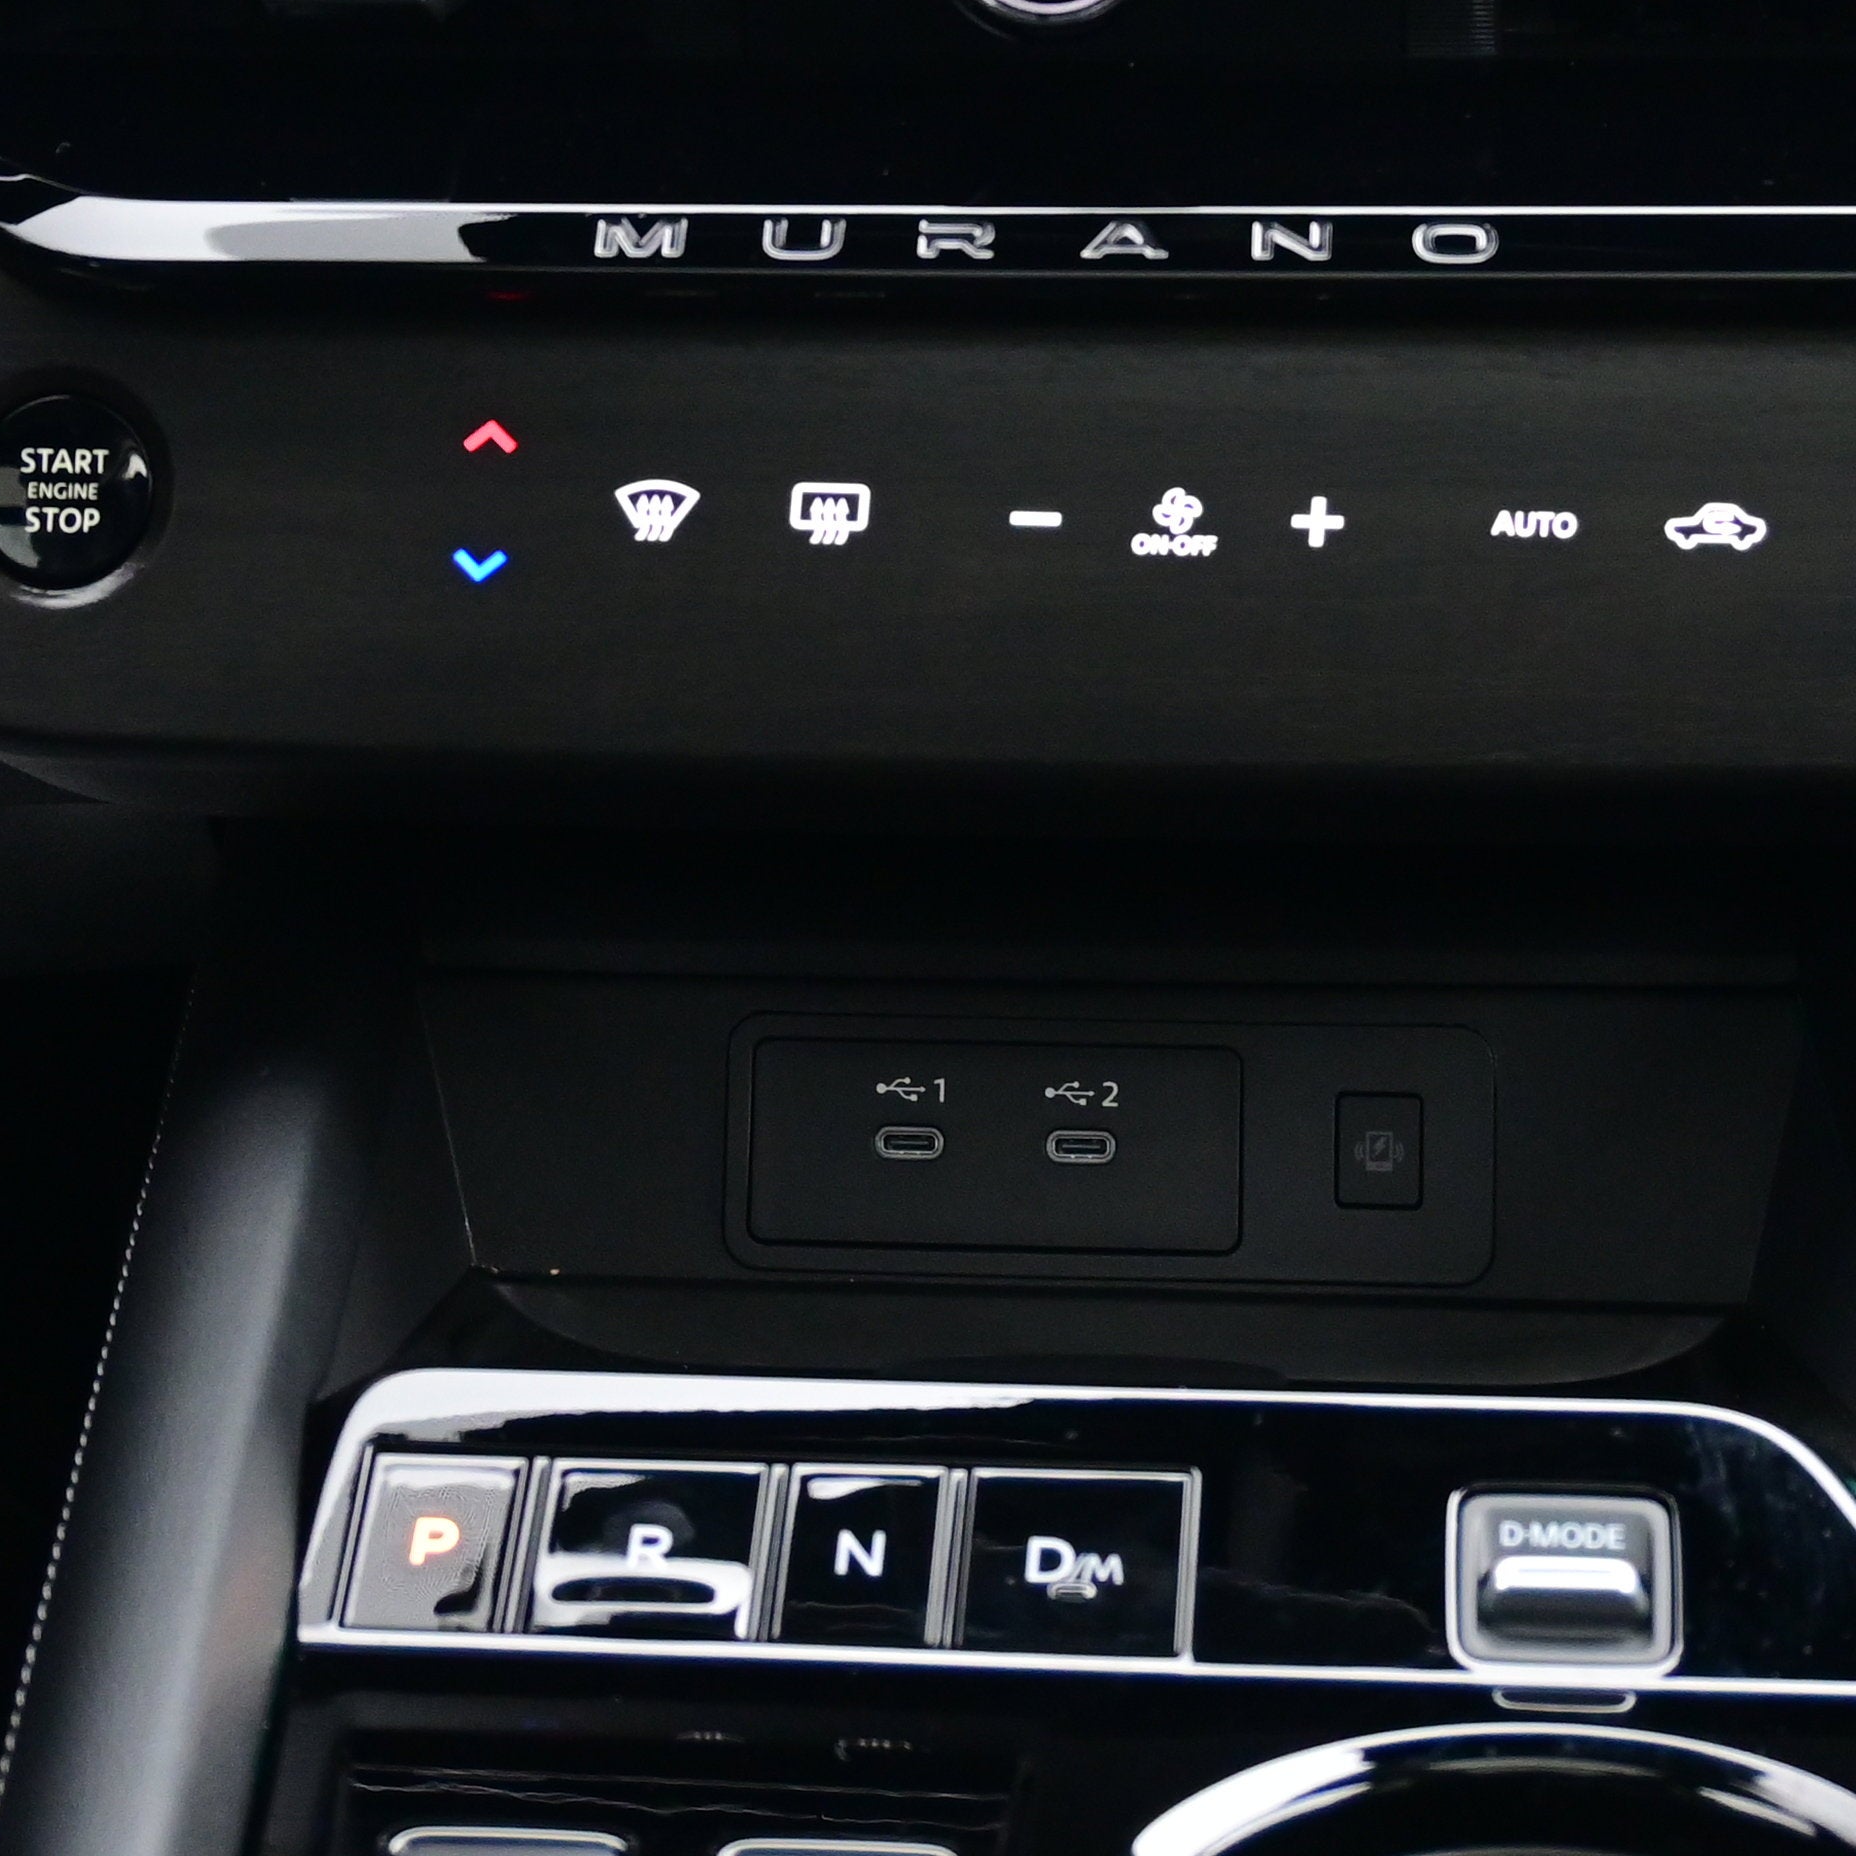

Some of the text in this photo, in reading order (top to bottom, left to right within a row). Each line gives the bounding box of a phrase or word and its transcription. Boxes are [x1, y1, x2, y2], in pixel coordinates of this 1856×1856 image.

[592, 215, 1501, 265] MURANO
[20, 447, 110, 474] START
[27, 482, 99, 501] ENGINE
[24, 506, 101, 534] STOP
[1490, 509, 1578, 539] AUTO
[932, 1077, 946, 1104] 1
[1101, 1081, 1120, 1109] 2
[410, 1514, 460, 1566] P
[625, 1523, 674, 1571] R
[833, 1529, 887, 1578] N
